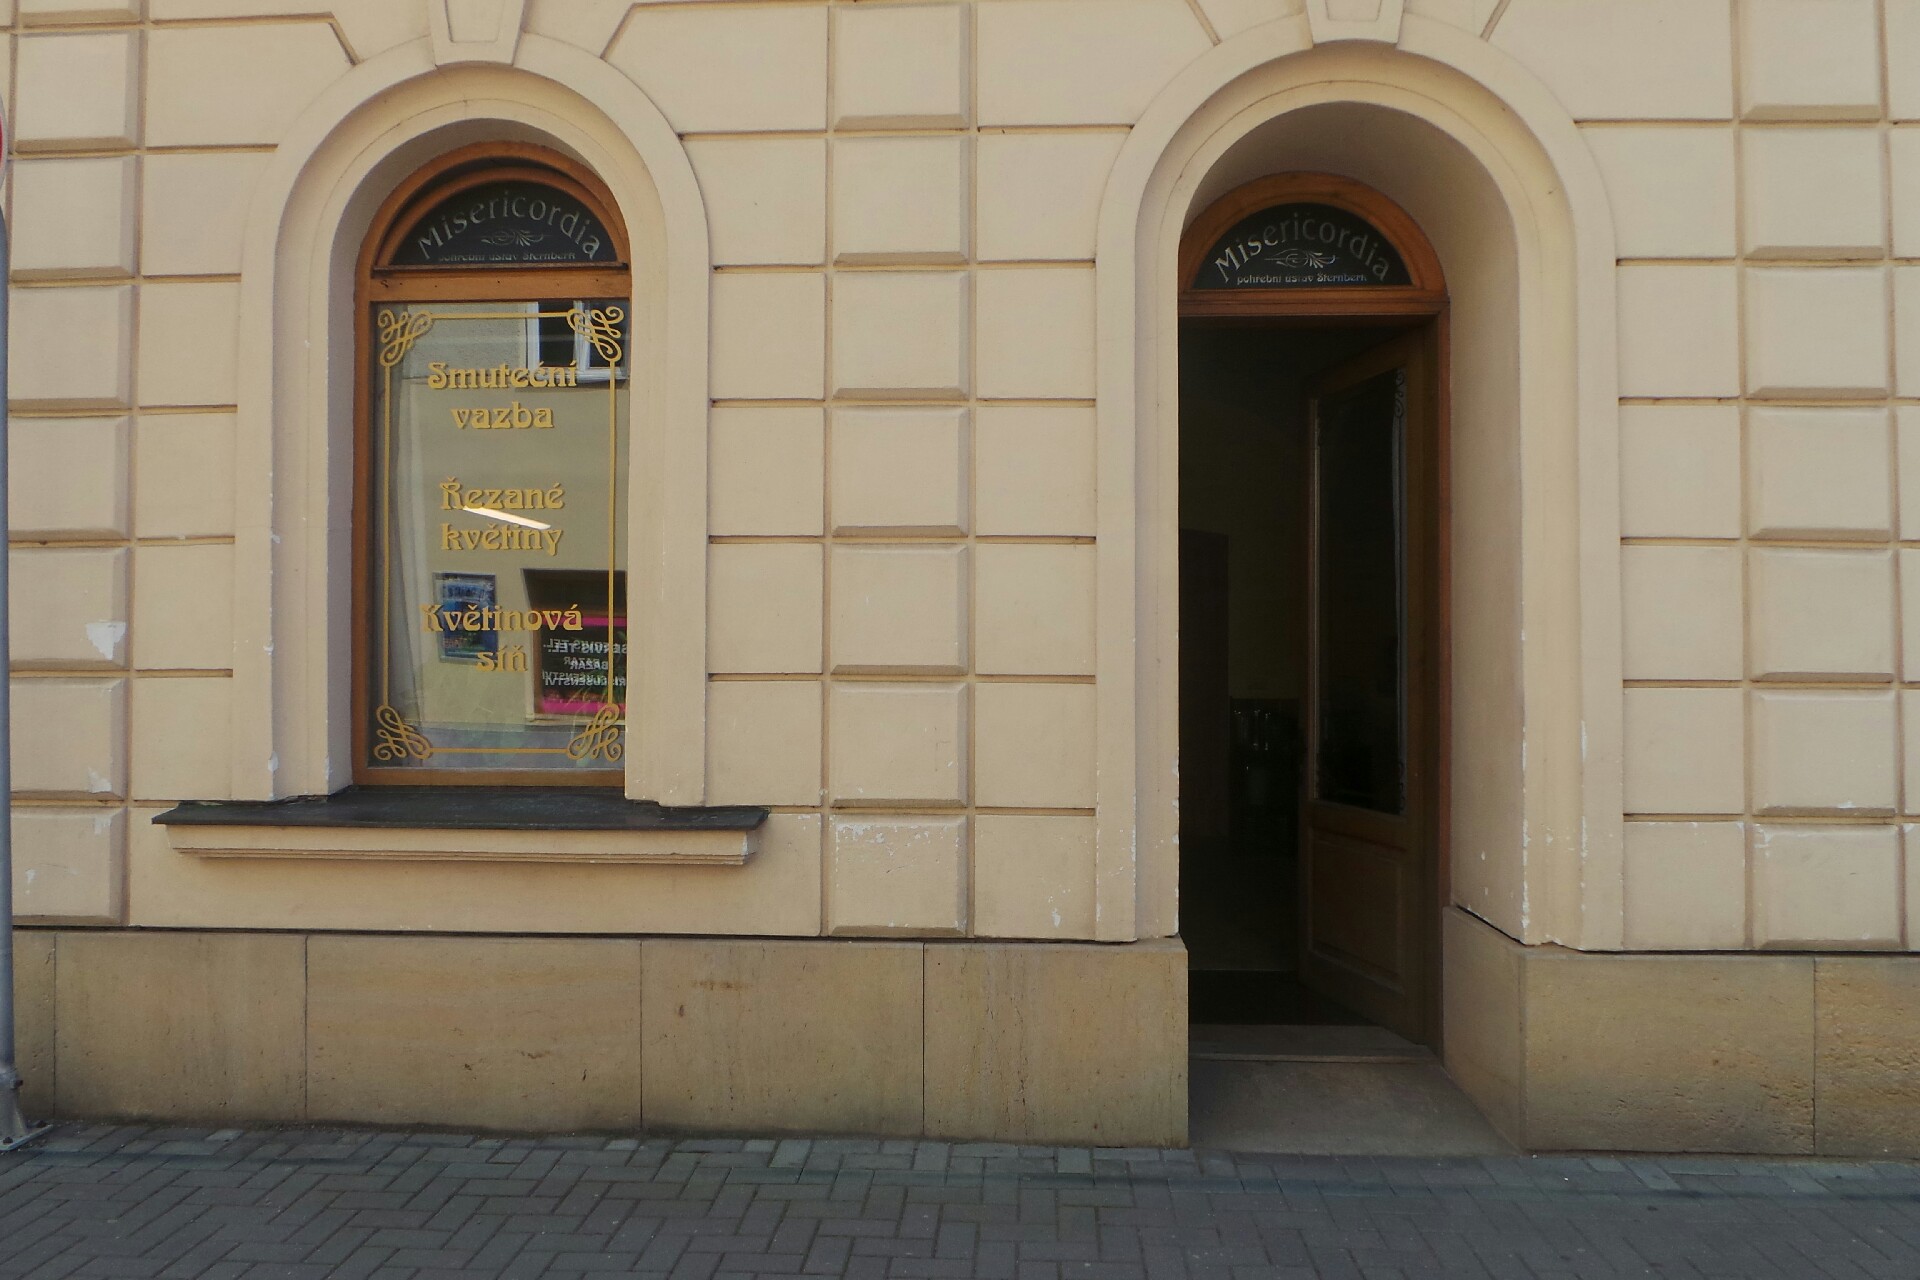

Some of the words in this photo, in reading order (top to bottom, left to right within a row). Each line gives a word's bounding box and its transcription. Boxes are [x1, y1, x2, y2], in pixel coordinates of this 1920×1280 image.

[417, 190, 600, 260] Misericordia
[1215, 212, 1390, 283] Misericordia
[427, 360, 577, 390] Smuteční
[451, 402, 554, 430] vazba
[440, 476, 565, 511] Řezané
[441, 523, 563, 556] květiny
[419, 603, 584, 632] Květinová
[475, 645, 528, 673] síň
